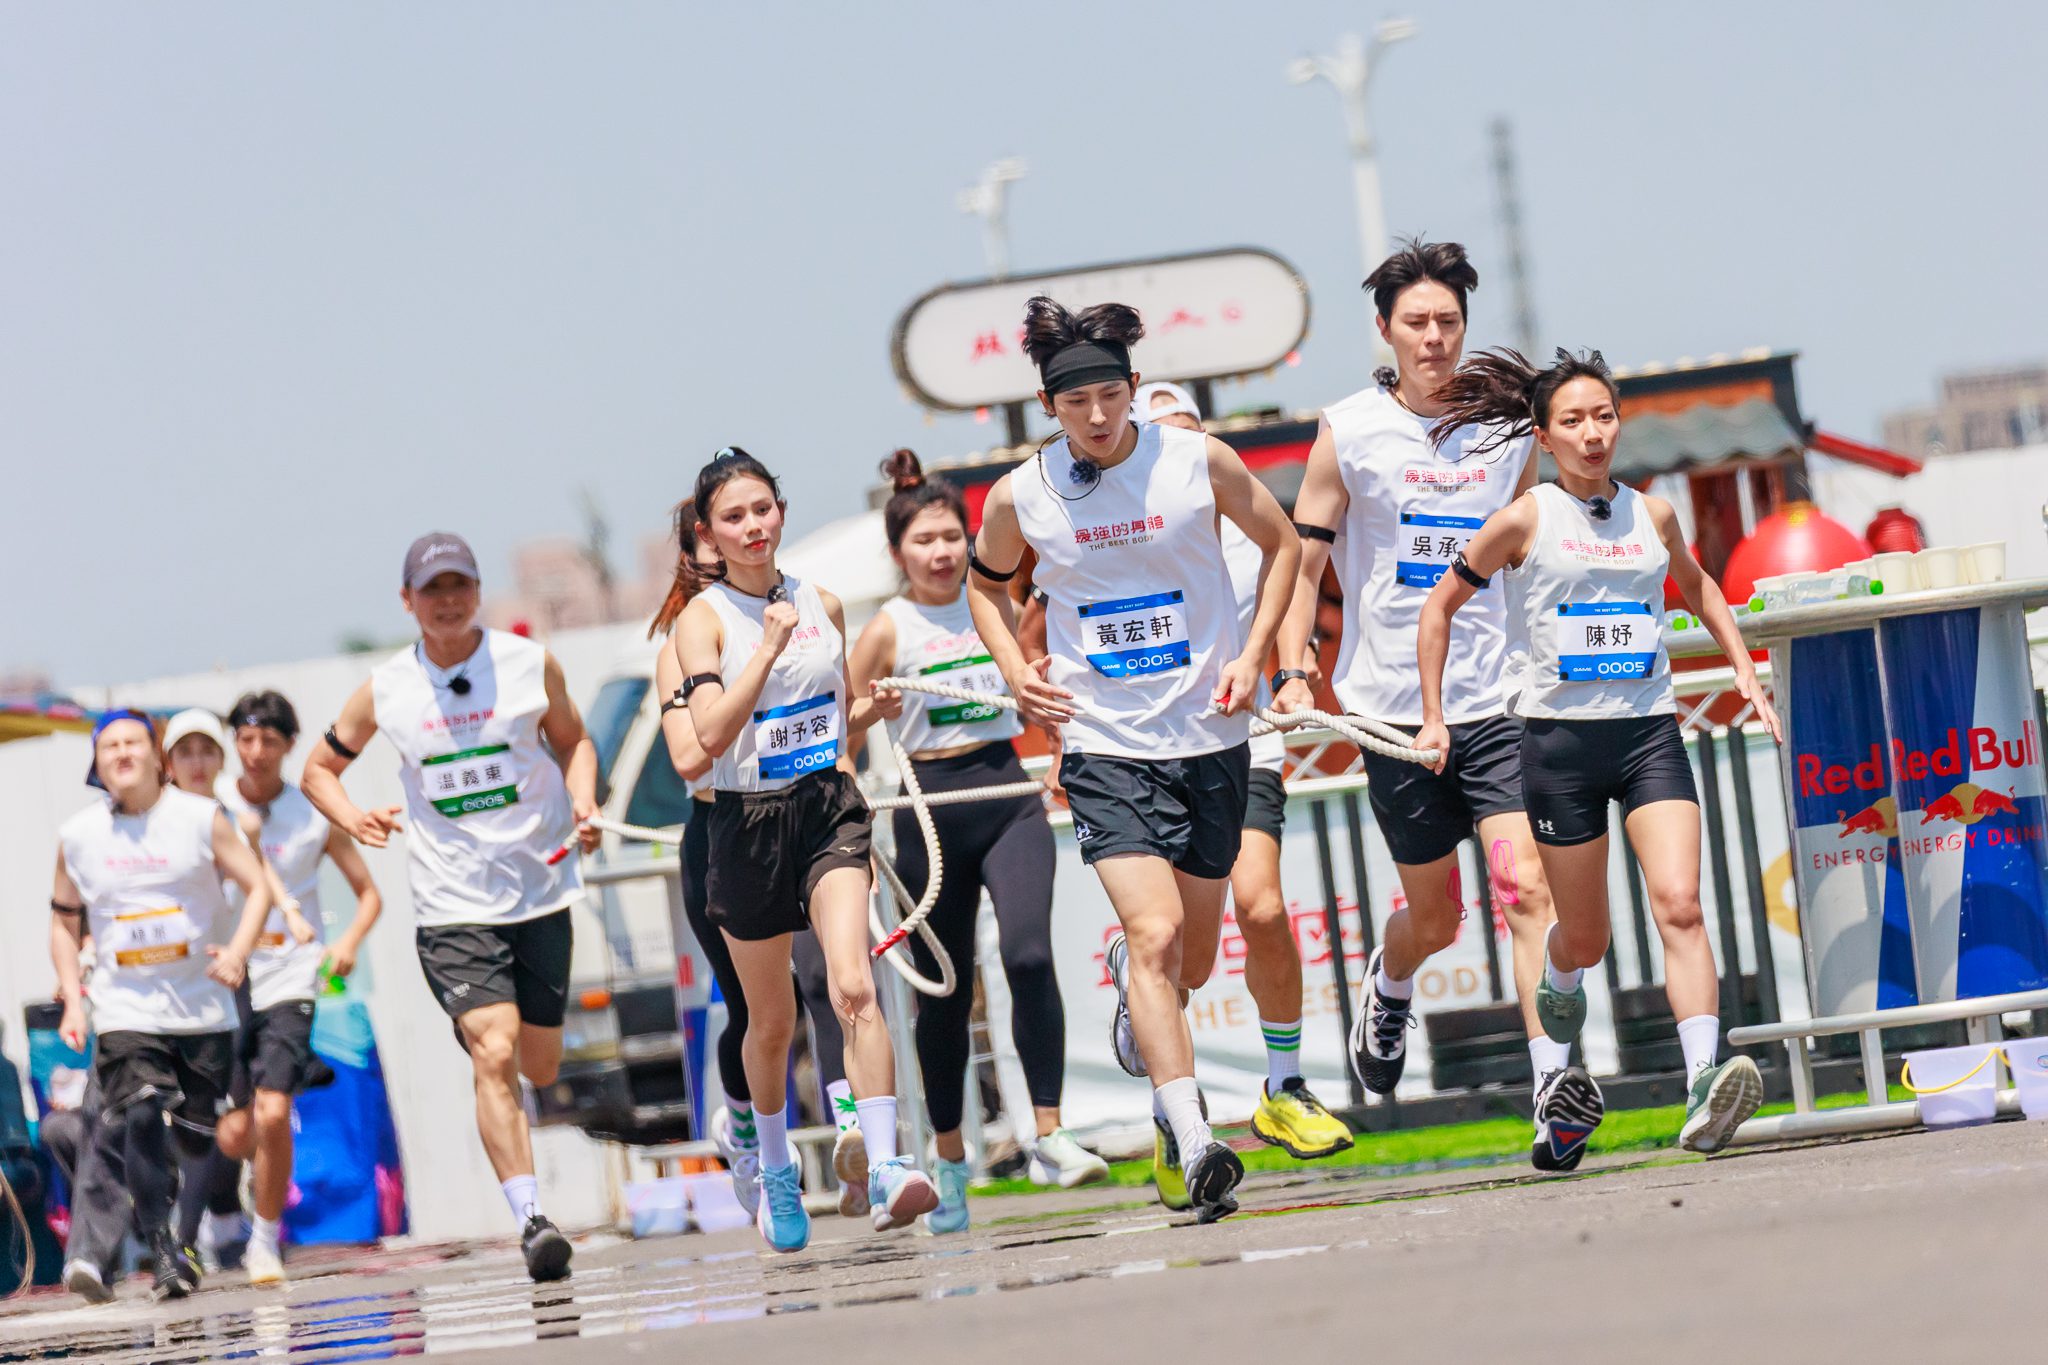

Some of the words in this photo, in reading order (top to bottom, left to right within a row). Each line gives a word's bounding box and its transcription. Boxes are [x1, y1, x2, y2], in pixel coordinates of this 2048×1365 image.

[1074, 515, 1164, 544] 最強的身體
[1089, 543, 1106, 552] THE
[1108, 538, 1129, 547] BEST
[1132, 534, 1154, 545] BODY
[1412, 536, 1471, 557] 吳承
[1575, 554, 1591, 562] THE
[1613, 558, 1635, 566] BODY
[1097, 615, 1173, 647] 黃宏軒
[1586, 624, 1632, 647] 陳妤
[1126, 652, 1174, 670] 0005
[1597, 661, 1645, 674] 0005
[770, 714, 829, 749] 謝予容
[1891, 728, 1962, 783] Red
[1967, 720, 2039, 772] Bull
[1797, 743, 1885, 798] Red
[1904, 830, 1977, 857] ENERGY
